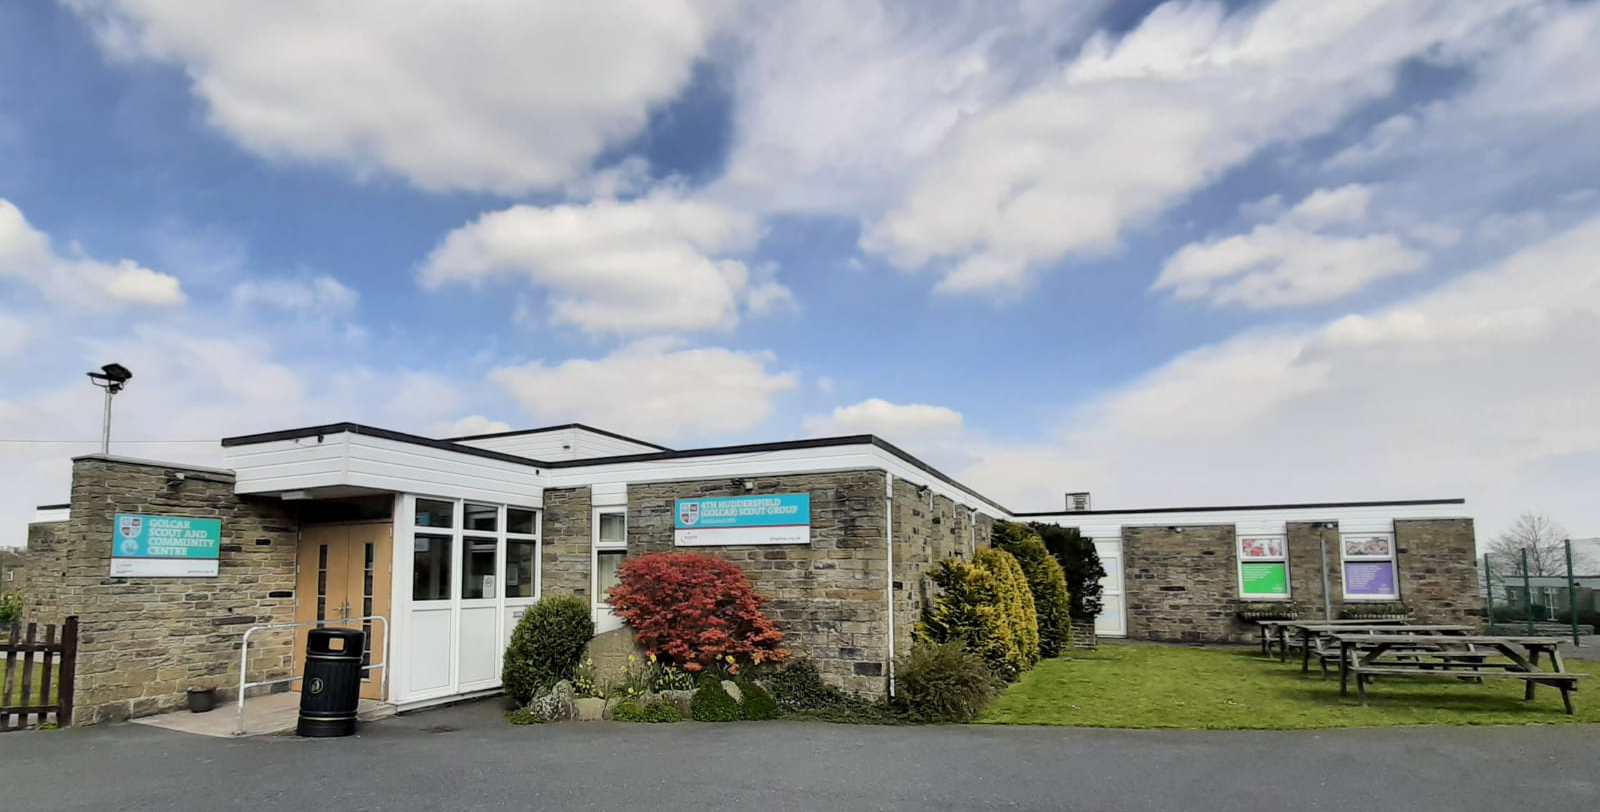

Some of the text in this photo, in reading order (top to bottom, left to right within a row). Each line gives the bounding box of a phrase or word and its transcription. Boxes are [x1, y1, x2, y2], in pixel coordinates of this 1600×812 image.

[719, 499, 781, 508] HUDDERSFIELD
[702, 506, 798, 517] (GOLCAR) SCOUT GROUP
[149, 519, 191, 529] GOLCAR
[148, 528, 208, 538] SCOUT AND
[148, 538, 215, 547] COMMUNITY
[147, 547, 188, 556] CENTRE
